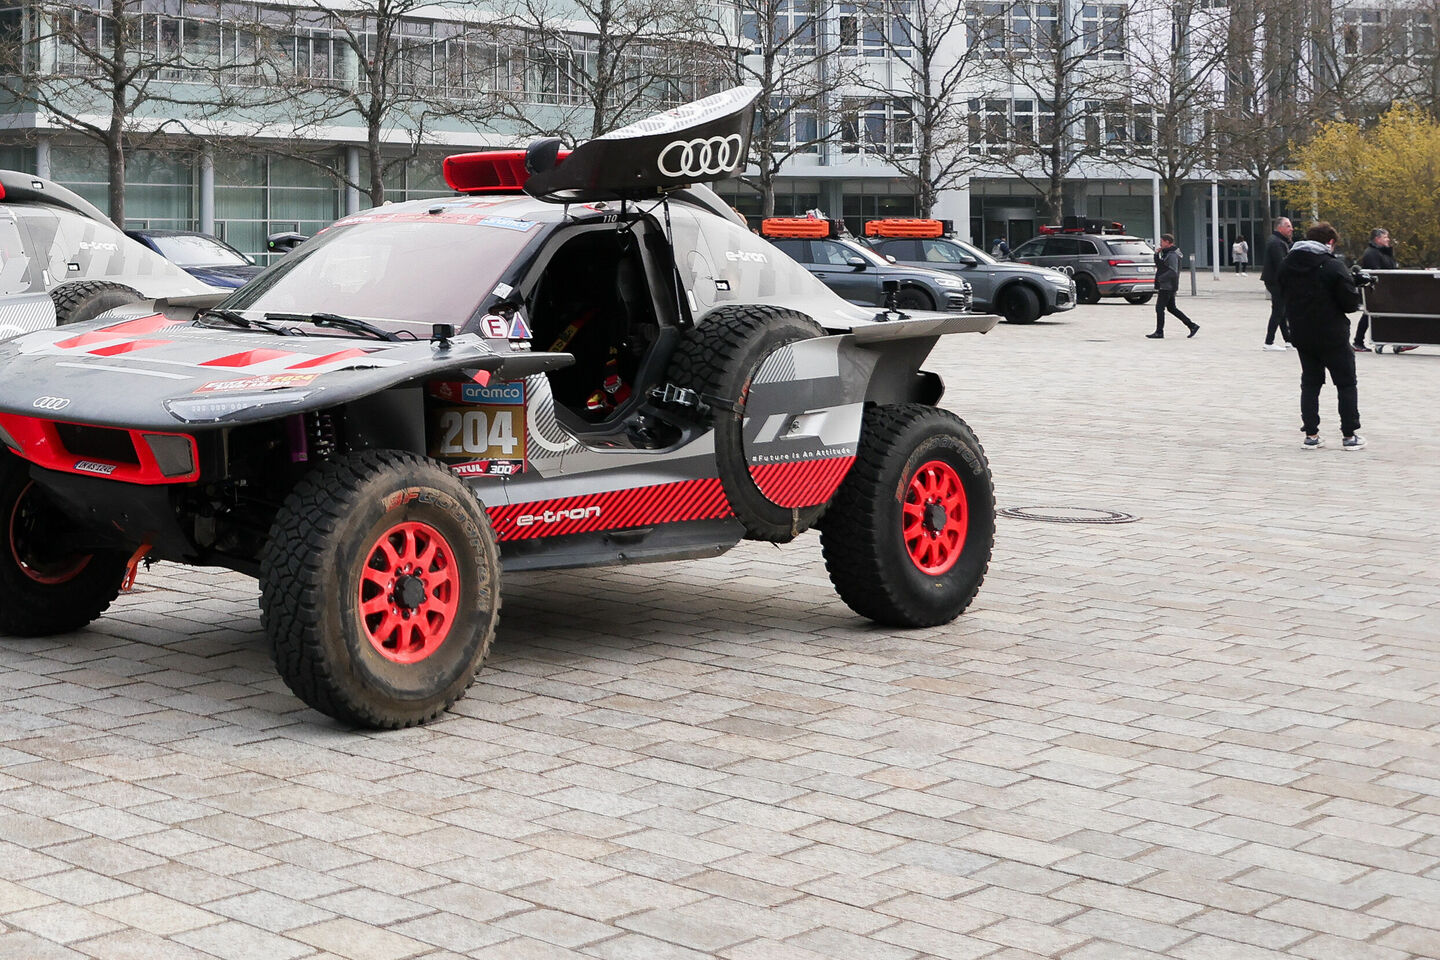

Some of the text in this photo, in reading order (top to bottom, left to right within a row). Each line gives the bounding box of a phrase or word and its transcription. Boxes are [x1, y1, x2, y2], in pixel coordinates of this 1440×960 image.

[603, 215, 618, 223] 110
[79, 241, 119, 251] e-tron
[725, 250, 768, 264] e-tron
[487, 319, 503, 337] E
[465, 387, 520, 399] aramco
[440, 410, 518, 455] 204
[752, 454, 790, 462] #Future
[815, 447, 851, 457] Attitude
[516, 506, 601, 526] e-tron
